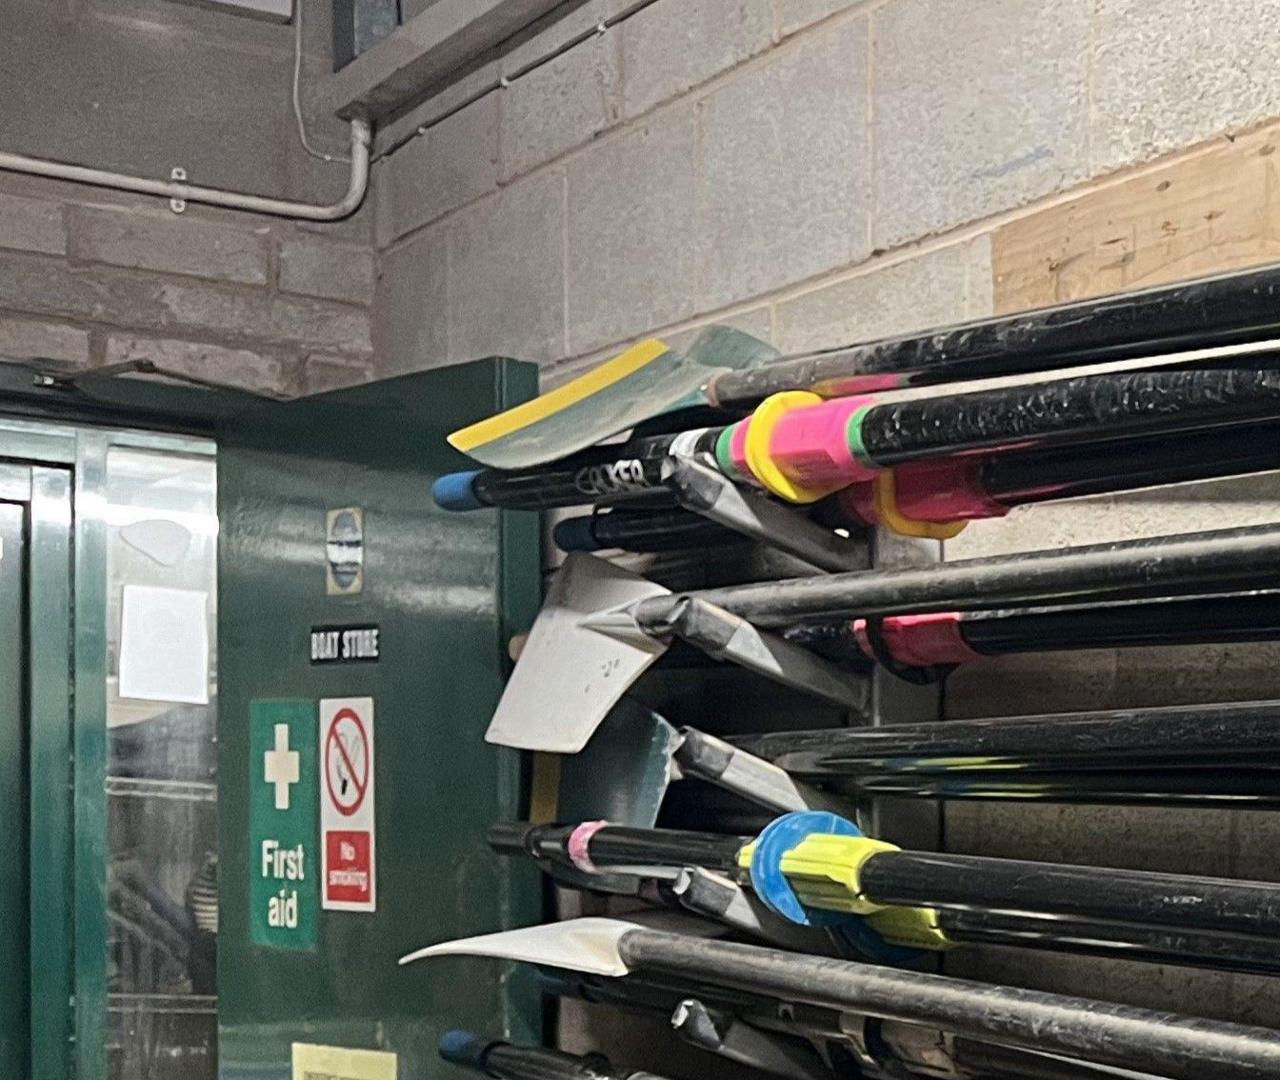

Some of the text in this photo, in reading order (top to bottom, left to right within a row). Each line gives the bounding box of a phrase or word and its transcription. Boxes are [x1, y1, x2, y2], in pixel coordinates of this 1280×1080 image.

[311, 628, 379, 660] BOAT STORE
[262, 840, 305, 880] First
[268, 889, 298, 928] aid
